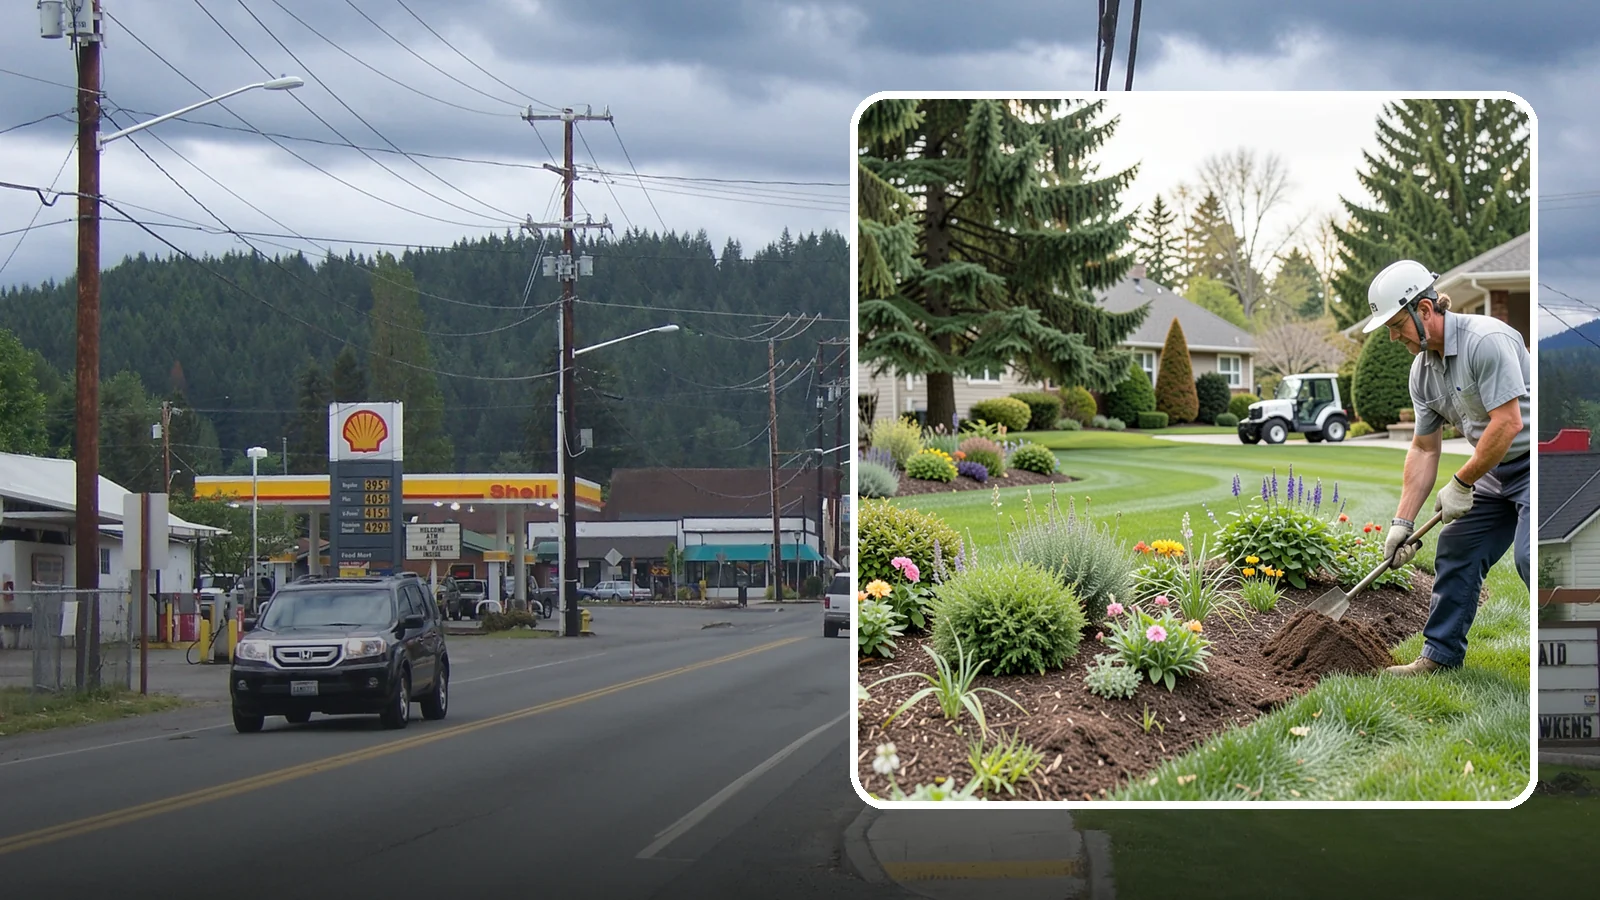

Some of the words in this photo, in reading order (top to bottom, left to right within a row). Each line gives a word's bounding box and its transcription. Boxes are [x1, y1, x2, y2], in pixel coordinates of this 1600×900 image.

[366, 479, 384, 490] 395
[490, 484, 547, 499] Shell
[366, 494, 384, 504] 405
[366, 508, 384, 518] 415
[366, 522, 384, 533] 429
